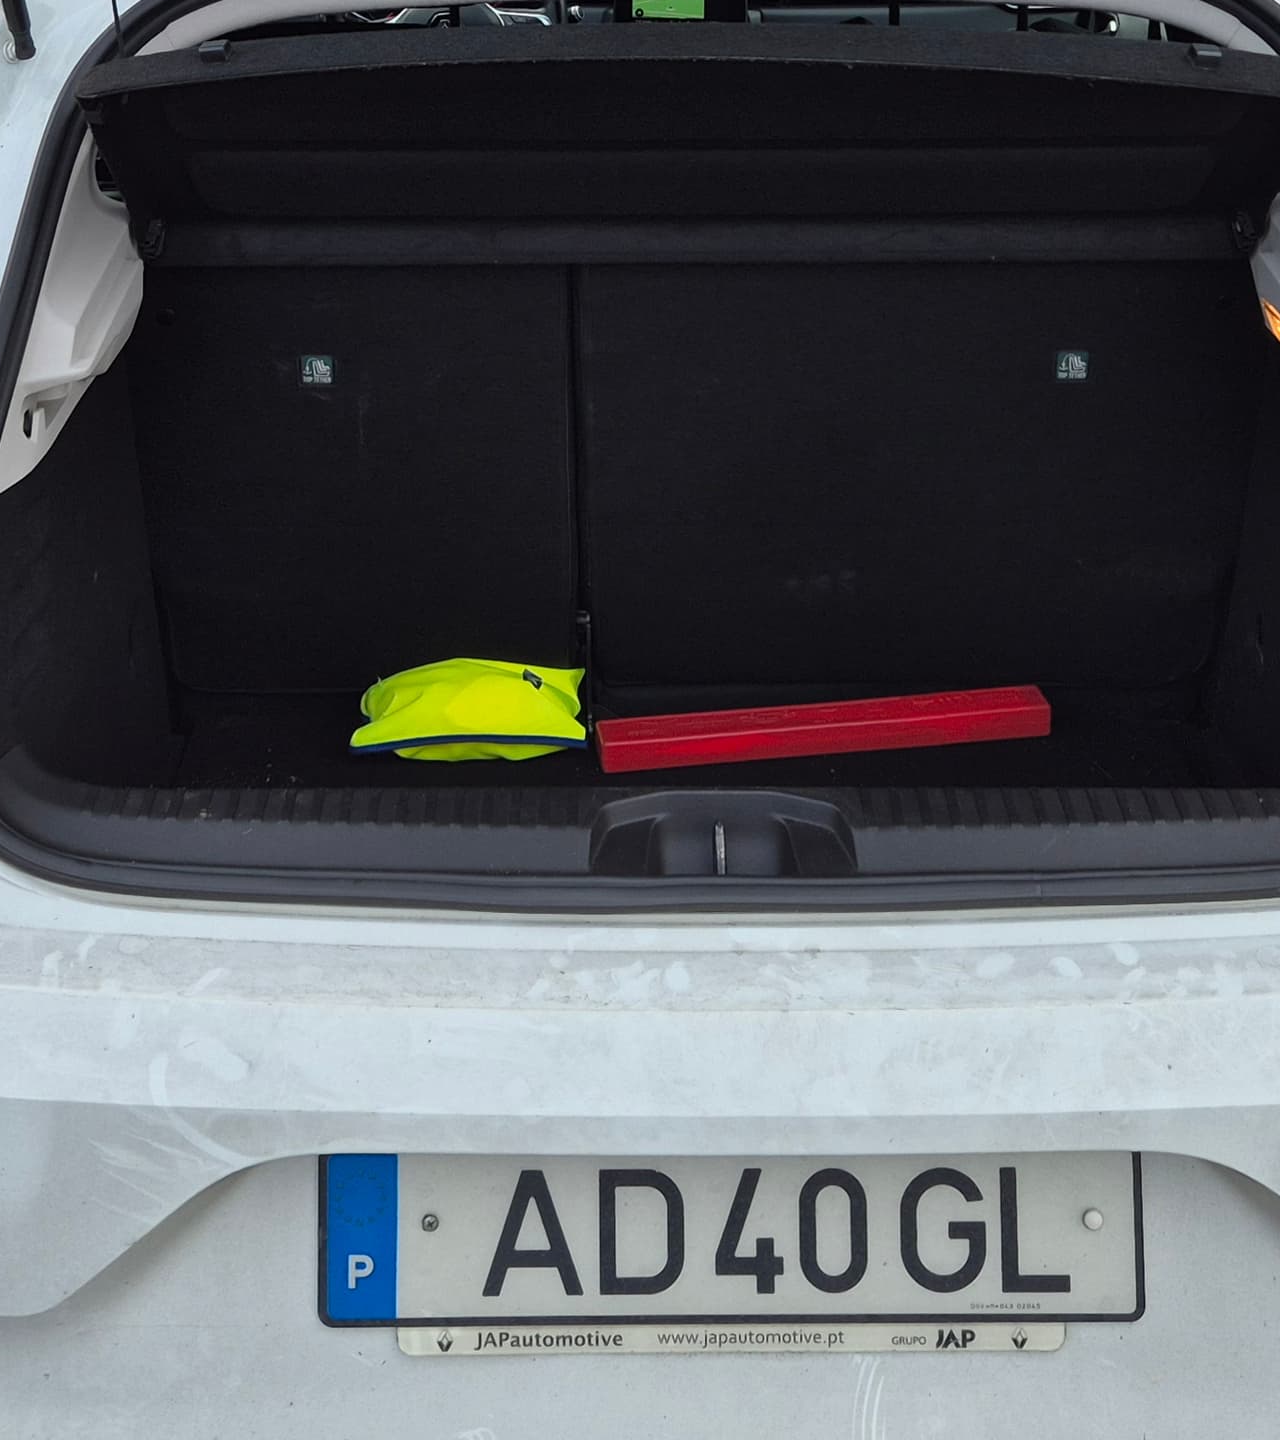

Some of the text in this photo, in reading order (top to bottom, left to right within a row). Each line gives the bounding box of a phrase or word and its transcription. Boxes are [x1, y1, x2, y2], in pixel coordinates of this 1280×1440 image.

[347, 1254, 375, 1289] P
[474, 1328, 977, 1351] JAPautomotive www.japautomotive.pt GRUPO JAP
